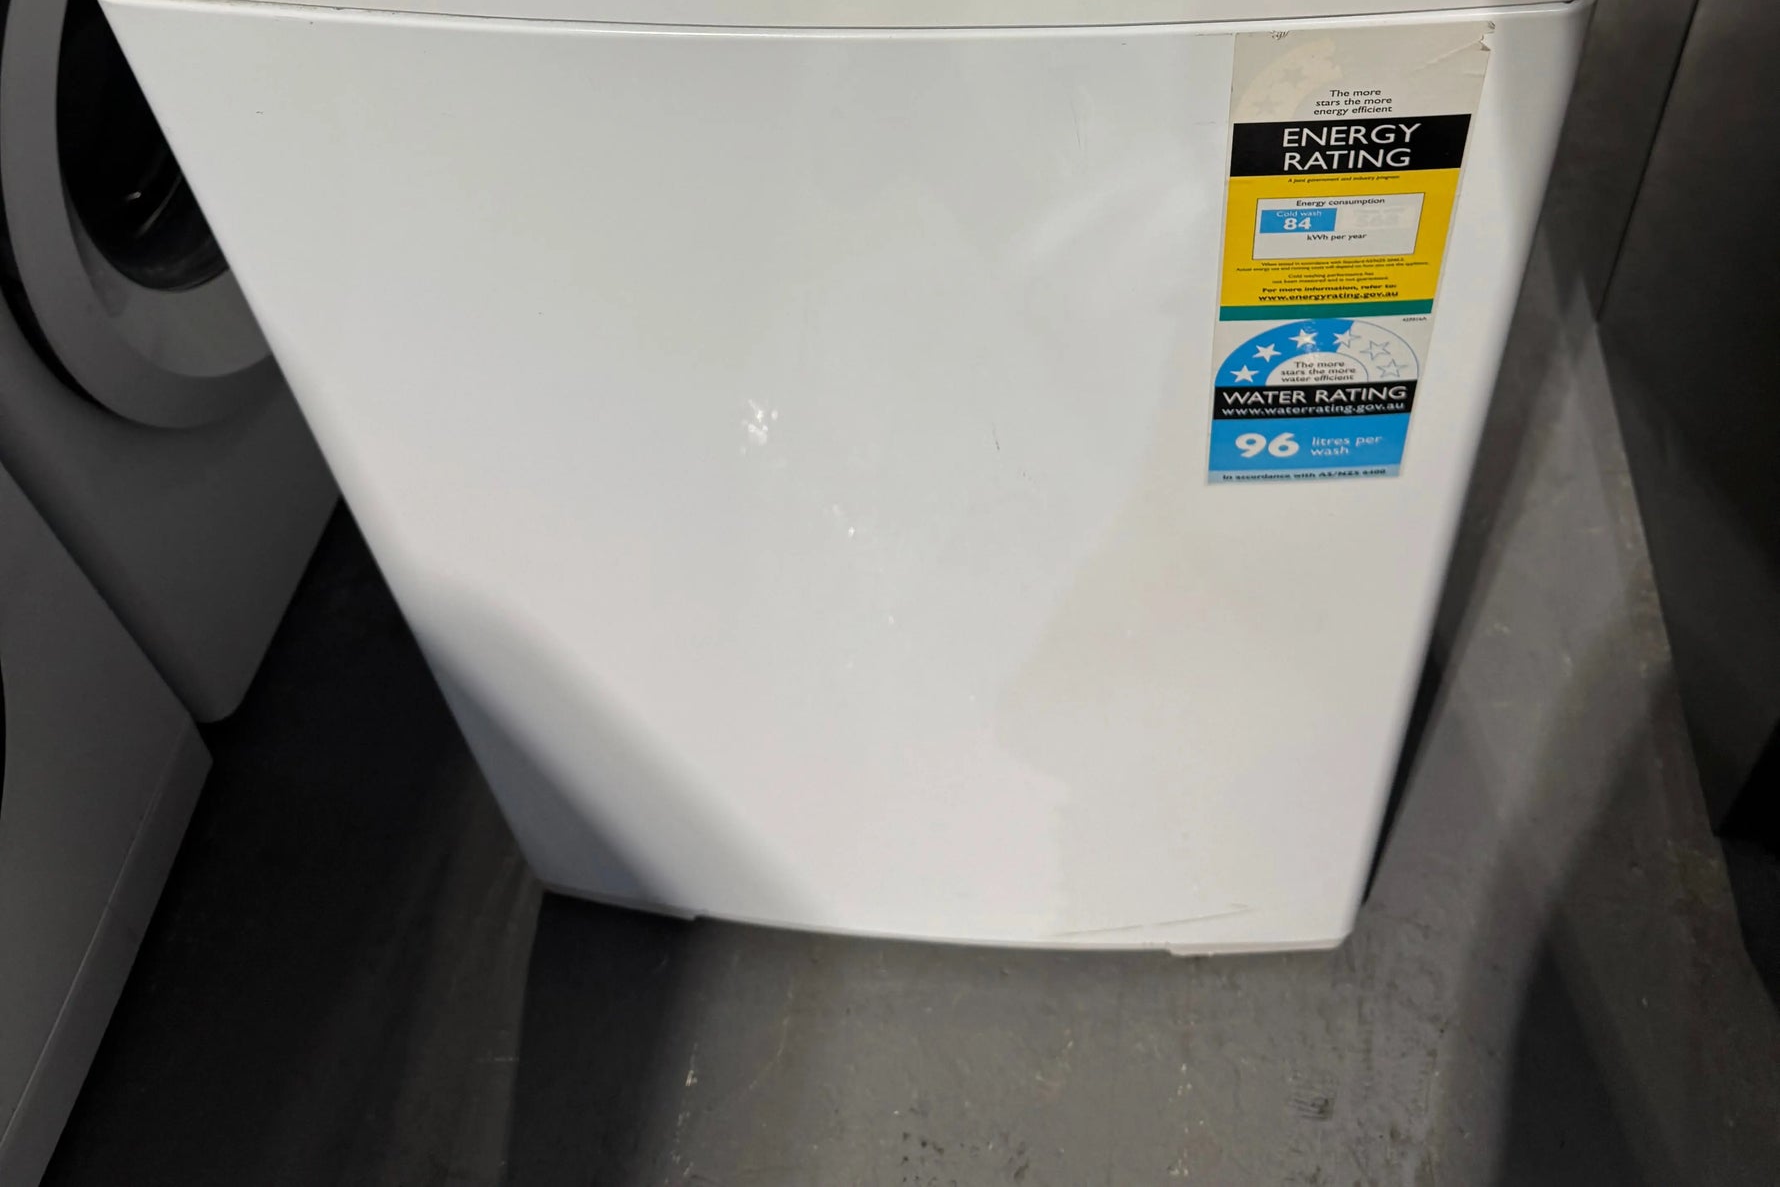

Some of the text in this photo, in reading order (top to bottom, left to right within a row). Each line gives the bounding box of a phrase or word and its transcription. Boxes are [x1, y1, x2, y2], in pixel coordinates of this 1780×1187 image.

[1330, 89, 1350, 97] The
[1313, 105, 1393, 116] energy efficient
[1282, 123, 1421, 147] ENERGY
[1283, 148, 1411, 171] RATING
[1296, 198, 1385, 207] Energy consumption
[1283, 217, 1312, 230] 84
[1258, 291, 1398, 301] www.energyrating.gov.au
[1313, 374, 1355, 382] efficient
[1223, 386, 1407, 405] WATER RATING
[1221, 401, 1405, 416] www.waterrating.gov.au
[1235, 432, 1300, 458] 96
[1312, 436, 1382, 447] litres per
[1310, 445, 1350, 456] wash
